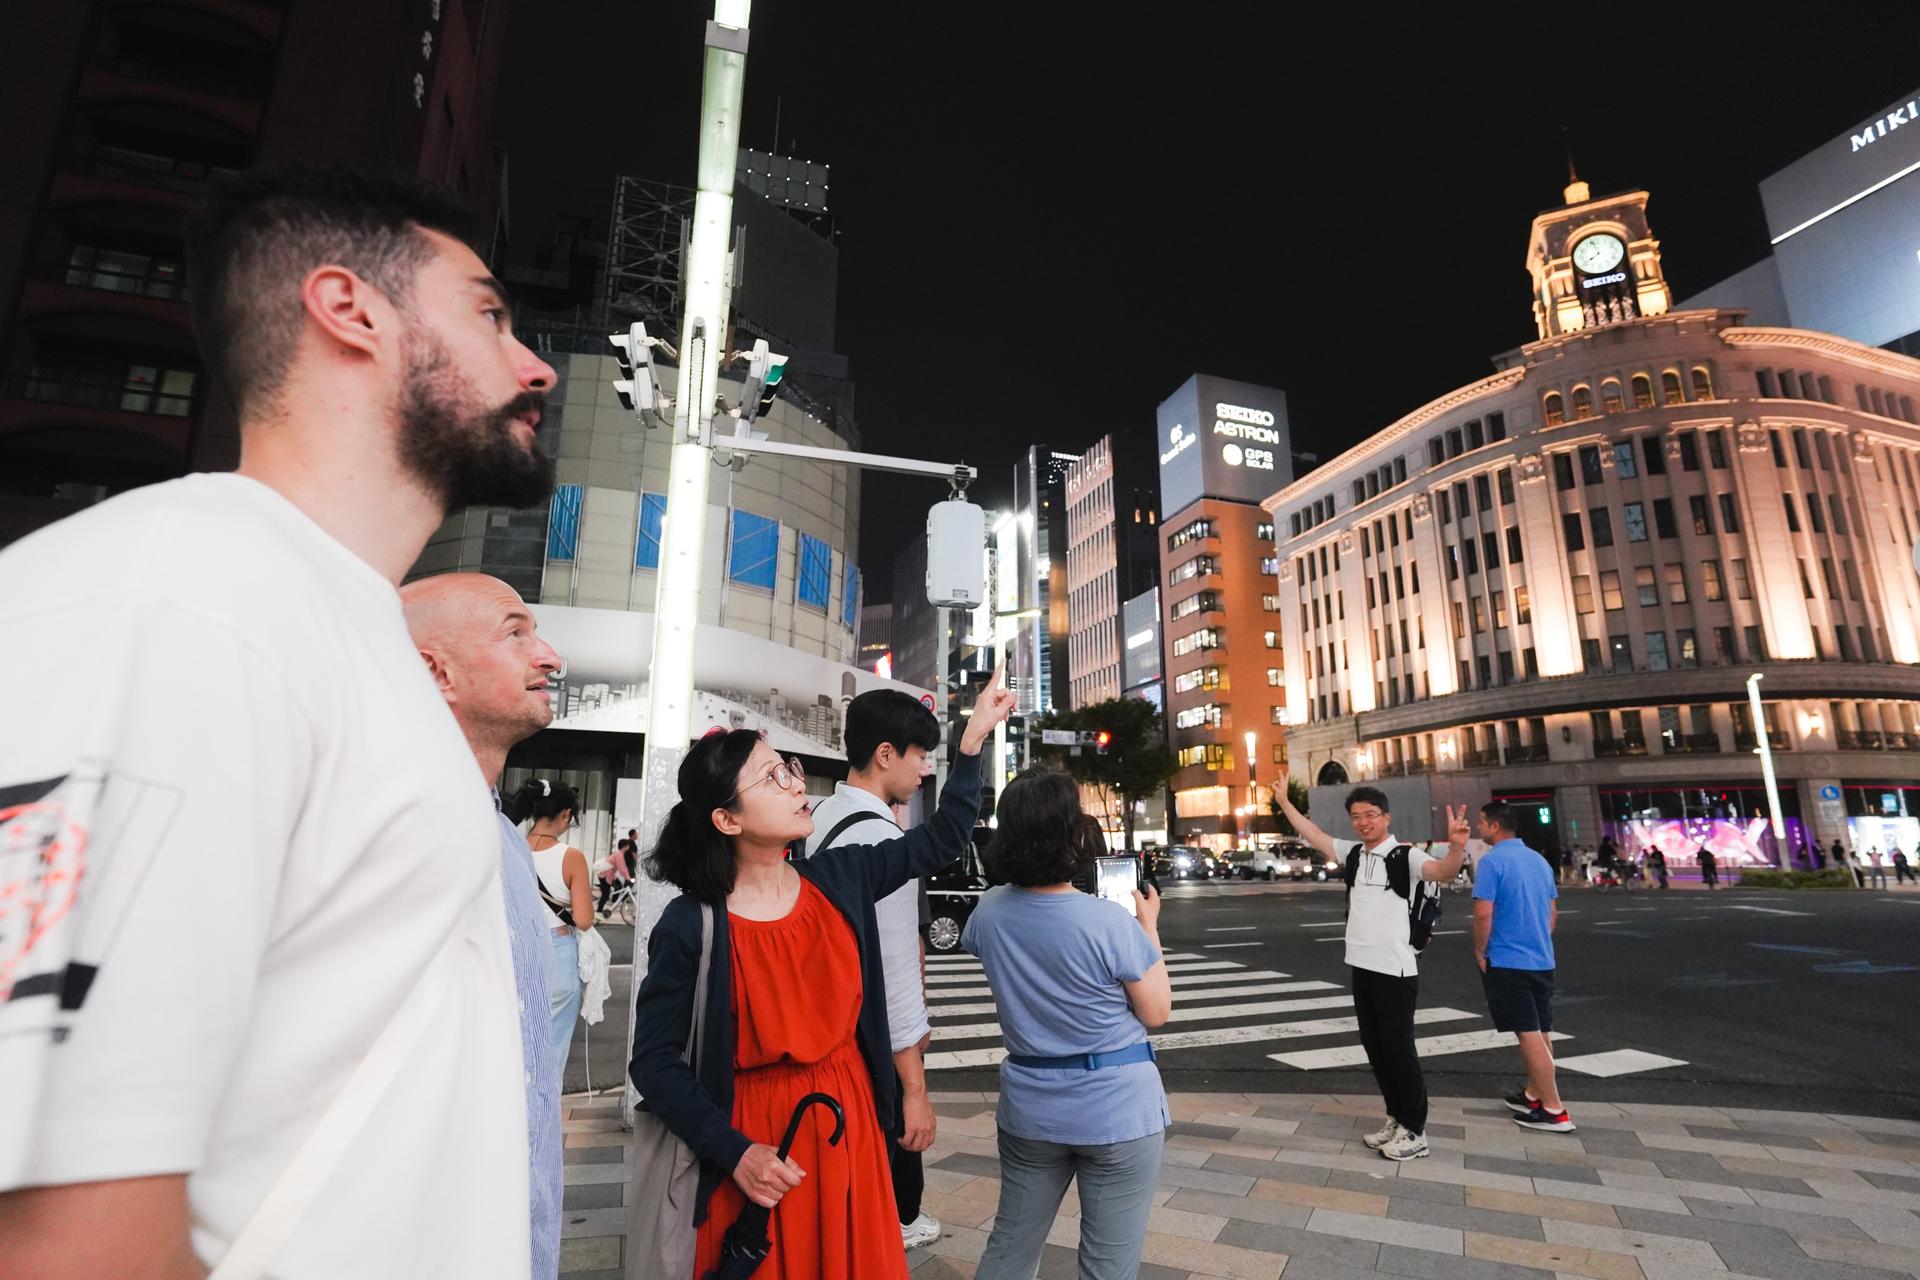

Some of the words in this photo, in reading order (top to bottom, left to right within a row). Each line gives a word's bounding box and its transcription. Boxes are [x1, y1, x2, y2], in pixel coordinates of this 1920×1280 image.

[1583, 273, 1626, 288] SEIKO
[1216, 403, 1274, 426] SEIKO
[1213, 420, 1279, 444] ASTRON
[1245, 448, 1273, 462] GPS
[1246, 459, 1273, 470] SOLAR
